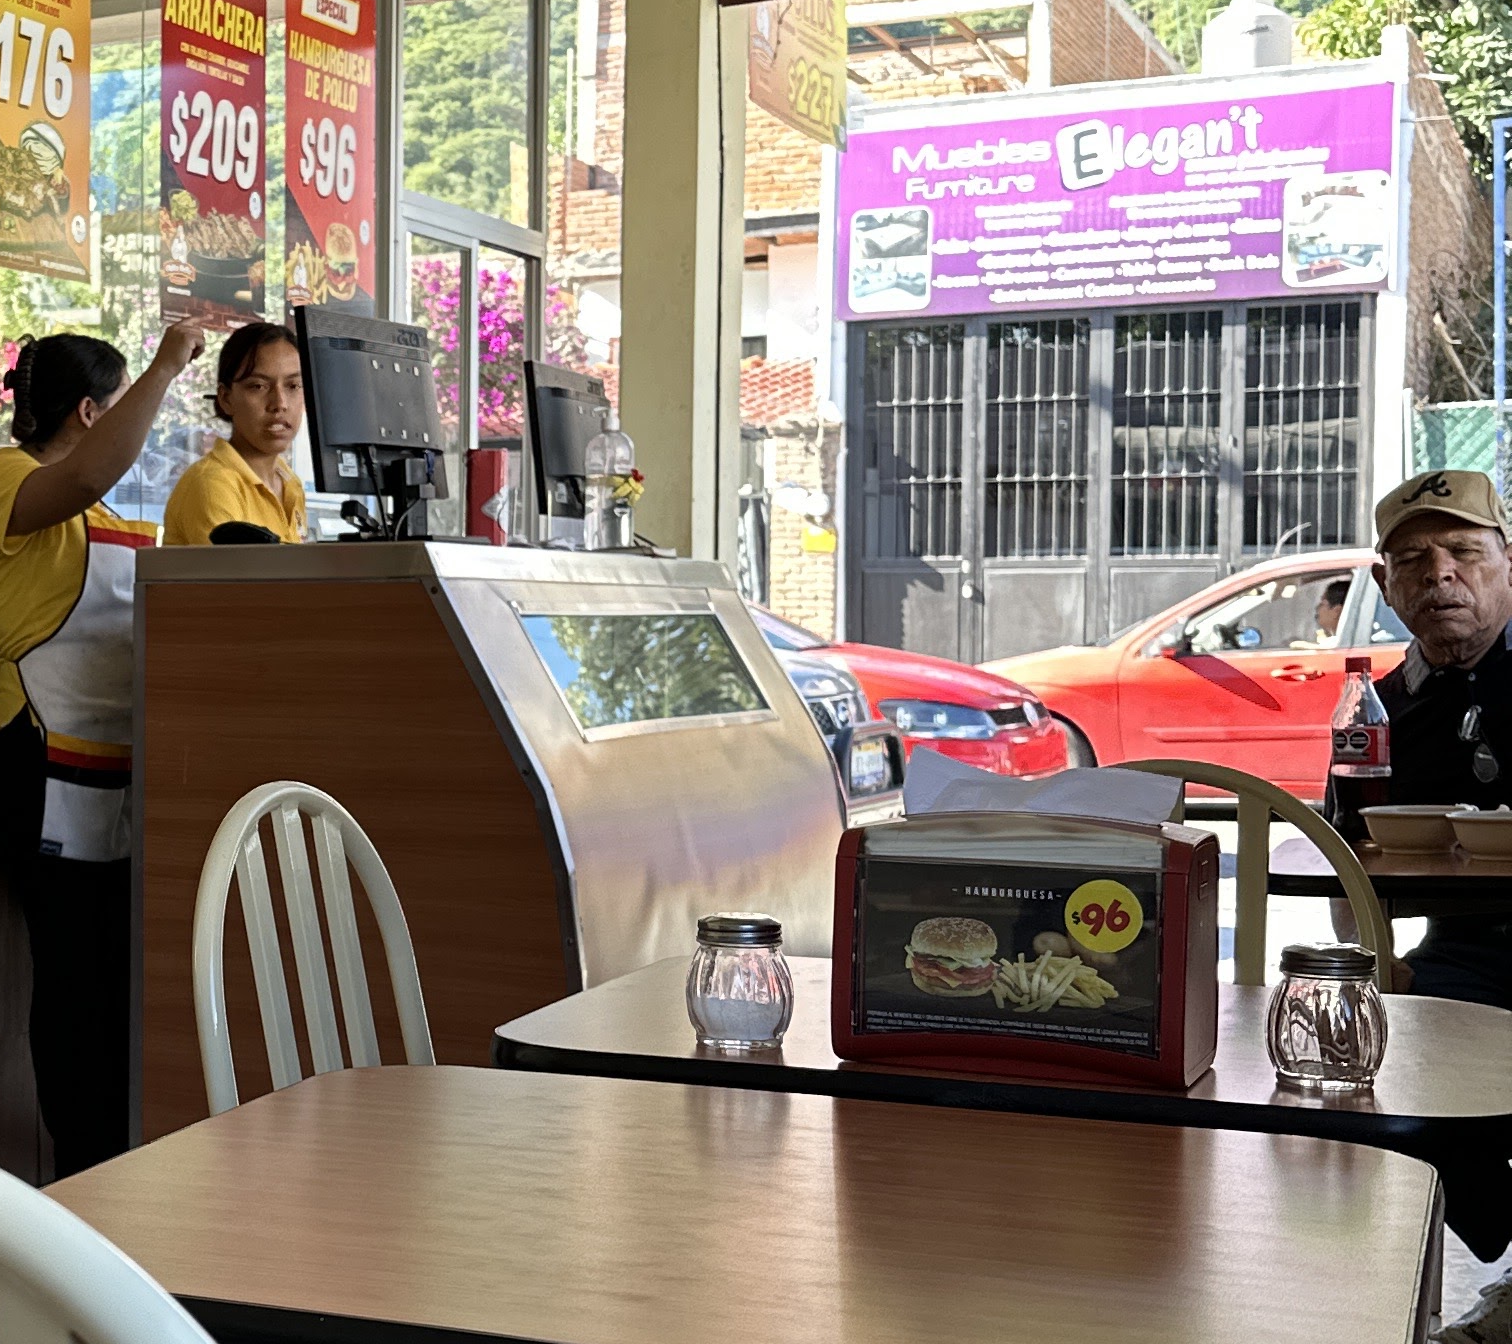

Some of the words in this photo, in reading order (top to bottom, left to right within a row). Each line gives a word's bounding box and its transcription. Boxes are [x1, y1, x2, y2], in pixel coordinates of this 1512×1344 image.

[289, 29, 372, 88] HAMBURGUESA
[304, 68, 321, 101] DE
[322, 74, 359, 114] POLLO
[788, 56, 834, 131] $227
[170, 90, 260, 192] $209
[299, 116, 357, 203] $96
[891, 138, 1053, 175] Muebles
[905, 171, 1036, 202] Furniture
[965, 886, 1054, 900] HAMBURGUESA
[1071, 899, 1131, 937] $96
